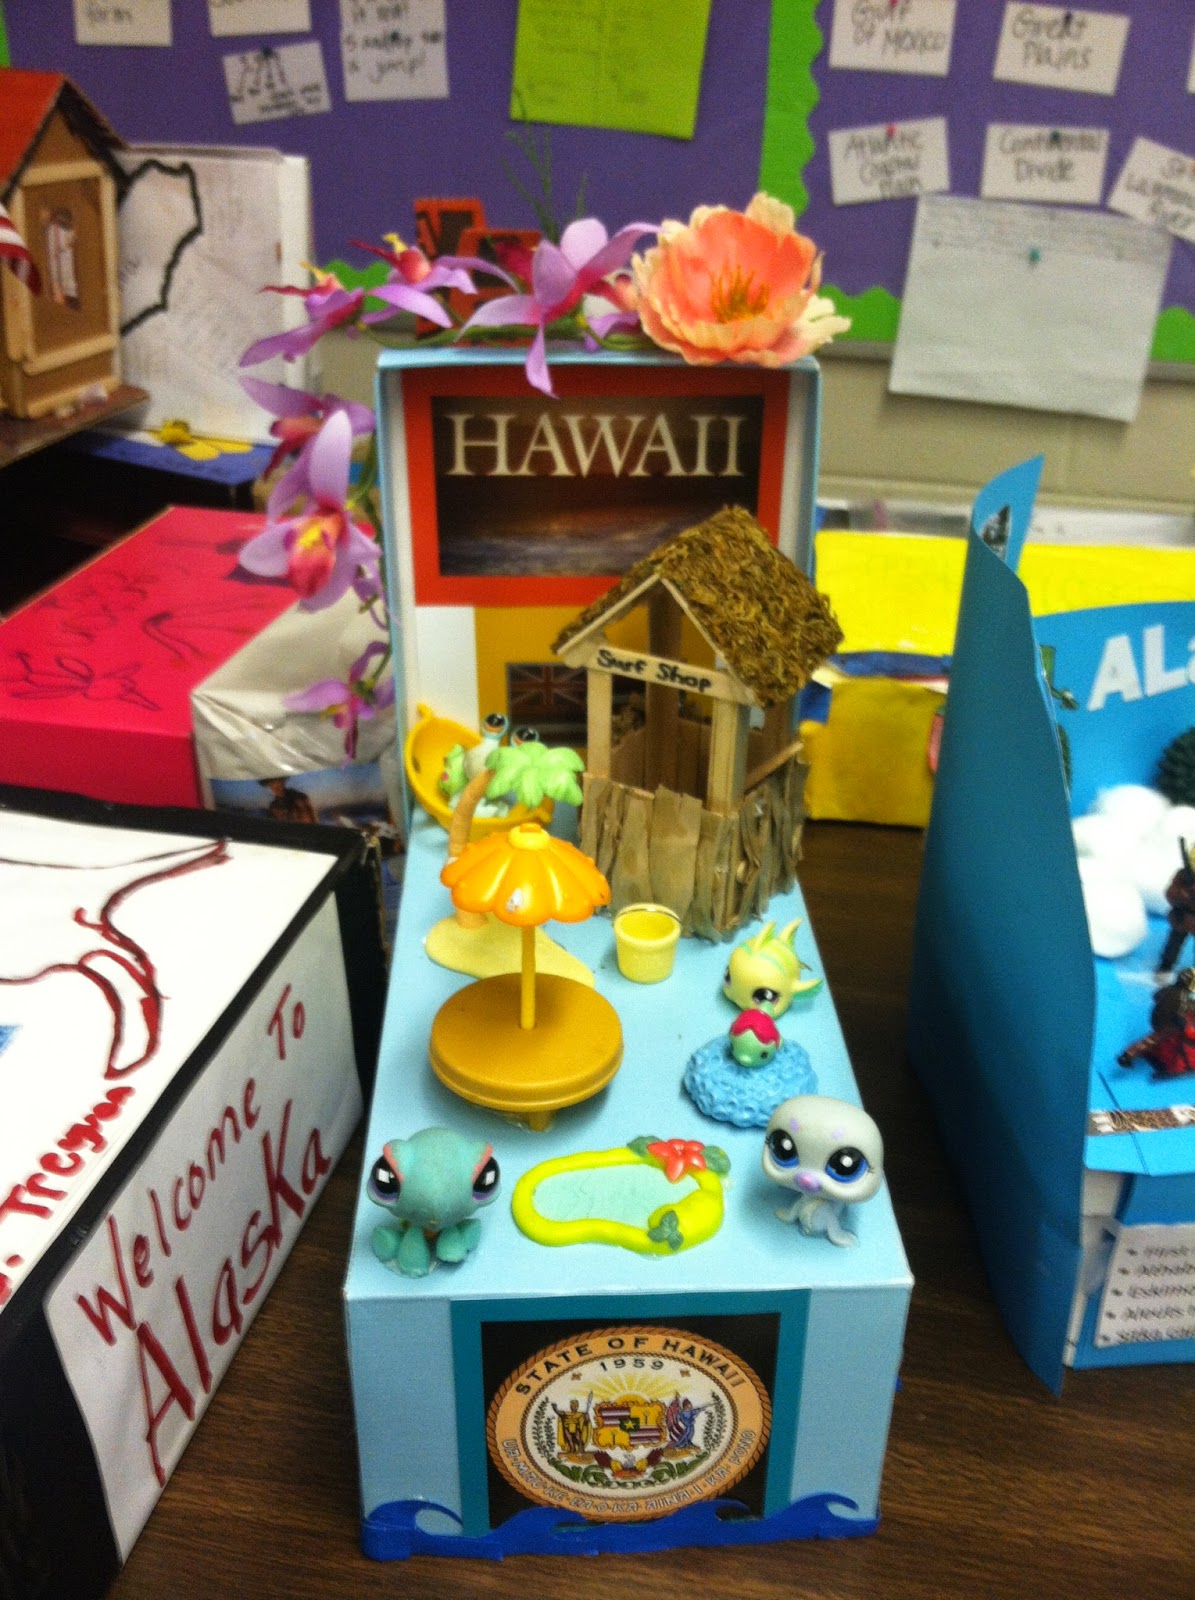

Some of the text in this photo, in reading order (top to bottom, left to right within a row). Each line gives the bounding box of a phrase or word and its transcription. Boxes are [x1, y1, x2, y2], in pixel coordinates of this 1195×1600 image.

[444, 412, 747, 478] HAWAII
[597, 648, 711, 693] Surf Shop
[1086, 623, 1195, 712] AL
[76, 1077, 261, 1347] Welcome
[514, 1336, 747, 1396] STATE OF HAWAII
[600, 1357, 665, 1372] 1959
